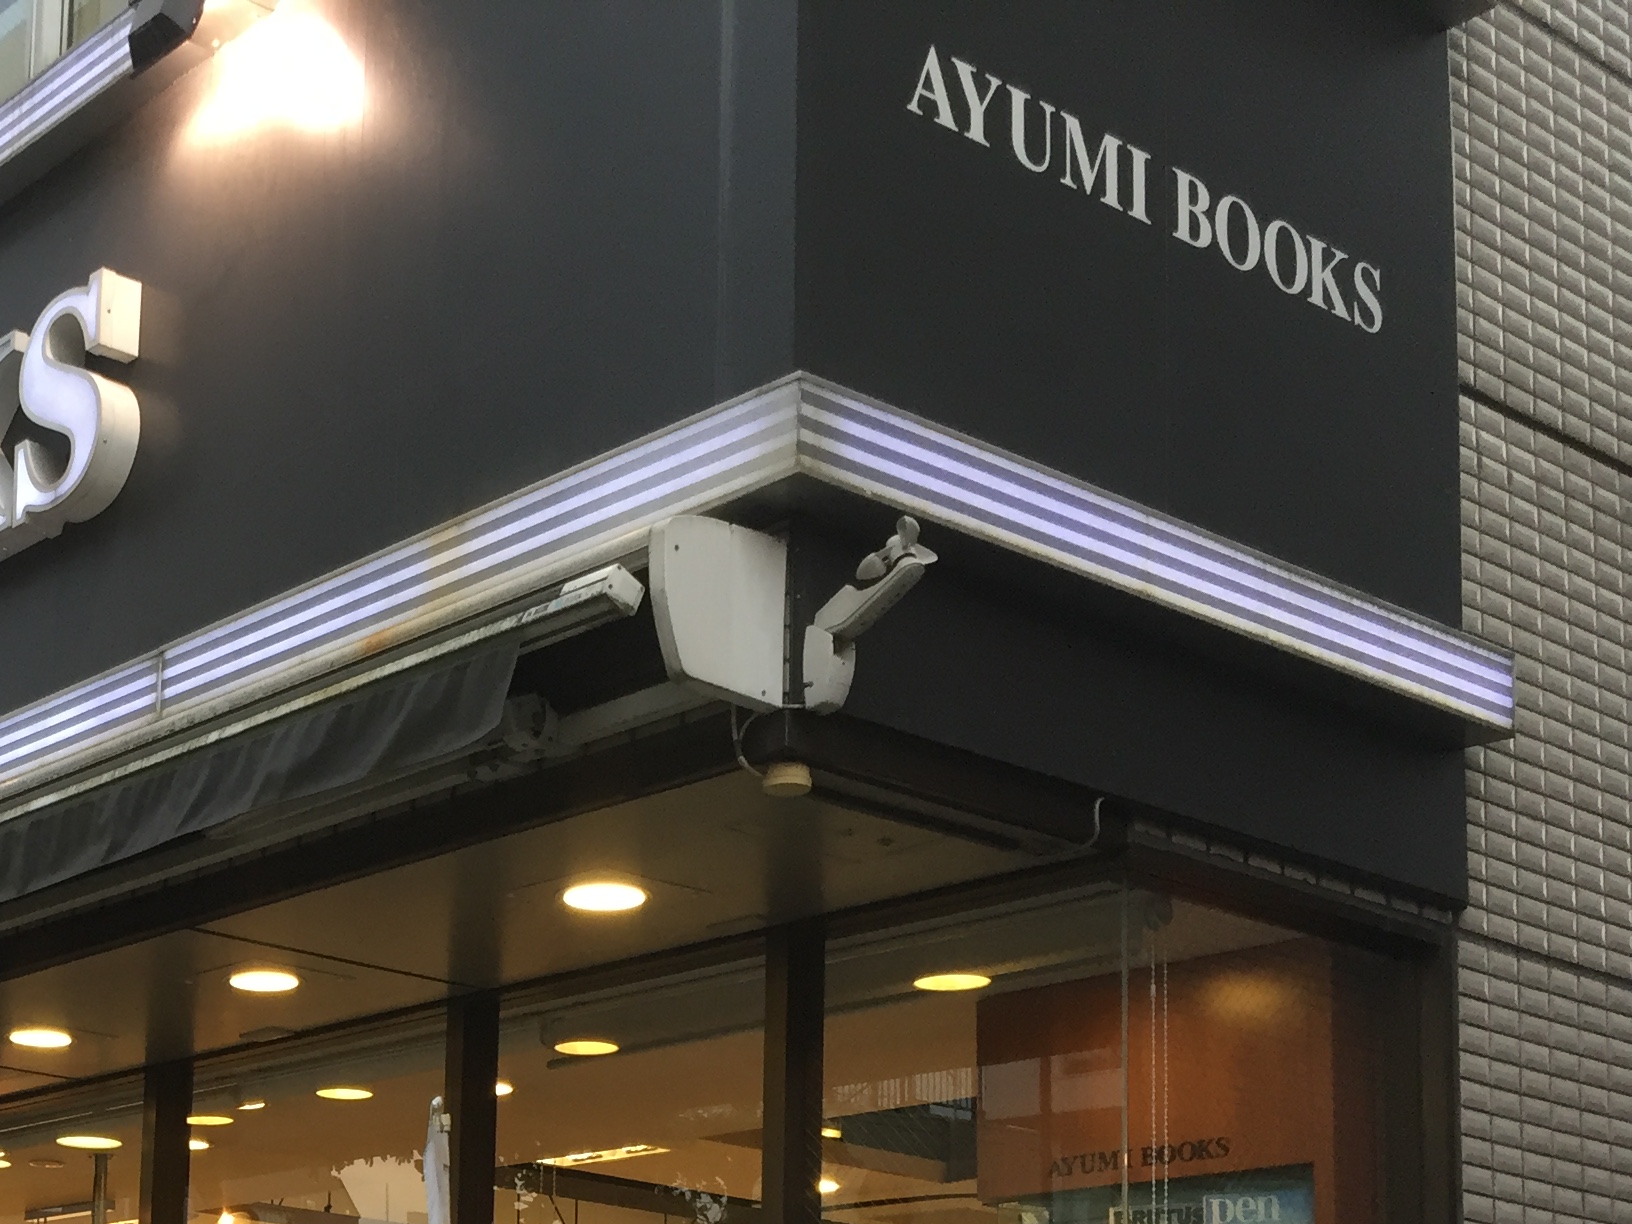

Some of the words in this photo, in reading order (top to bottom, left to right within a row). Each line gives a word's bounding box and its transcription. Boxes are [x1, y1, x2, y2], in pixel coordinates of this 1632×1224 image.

[907, 45, 1151, 225] AYUMI
[1172, 166, 1383, 334] BOOKS
[1048, 1151, 1133, 1177] AYUMI
[1141, 1136, 1231, 1168] BOOKS
